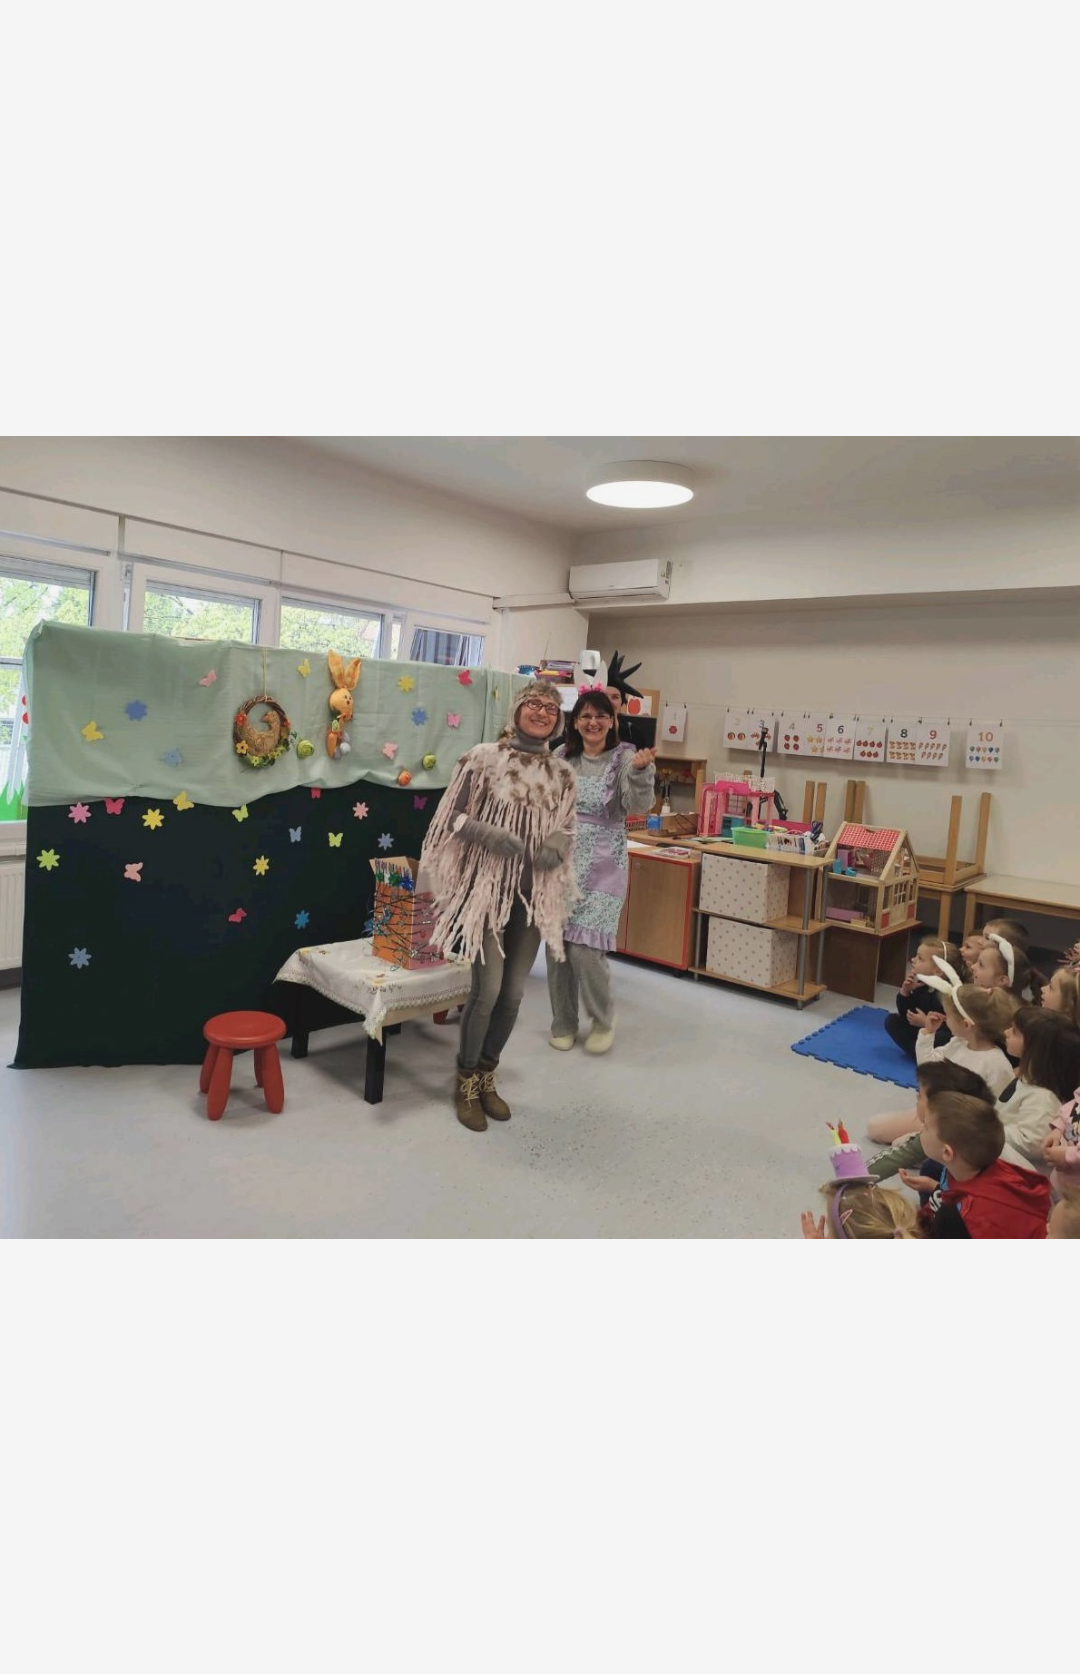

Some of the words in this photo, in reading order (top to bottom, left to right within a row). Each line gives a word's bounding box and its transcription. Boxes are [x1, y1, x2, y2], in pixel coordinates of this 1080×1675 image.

[759, 719, 765, 728] 3
[789, 722, 795, 730] 4
[816, 723, 823, 733] 5
[837, 725, 845, 734] 6
[867, 726, 875, 735] 7
[900, 728, 908, 738] 8
[929, 730, 937, 740] 9
[978, 731, 994, 742] 10
